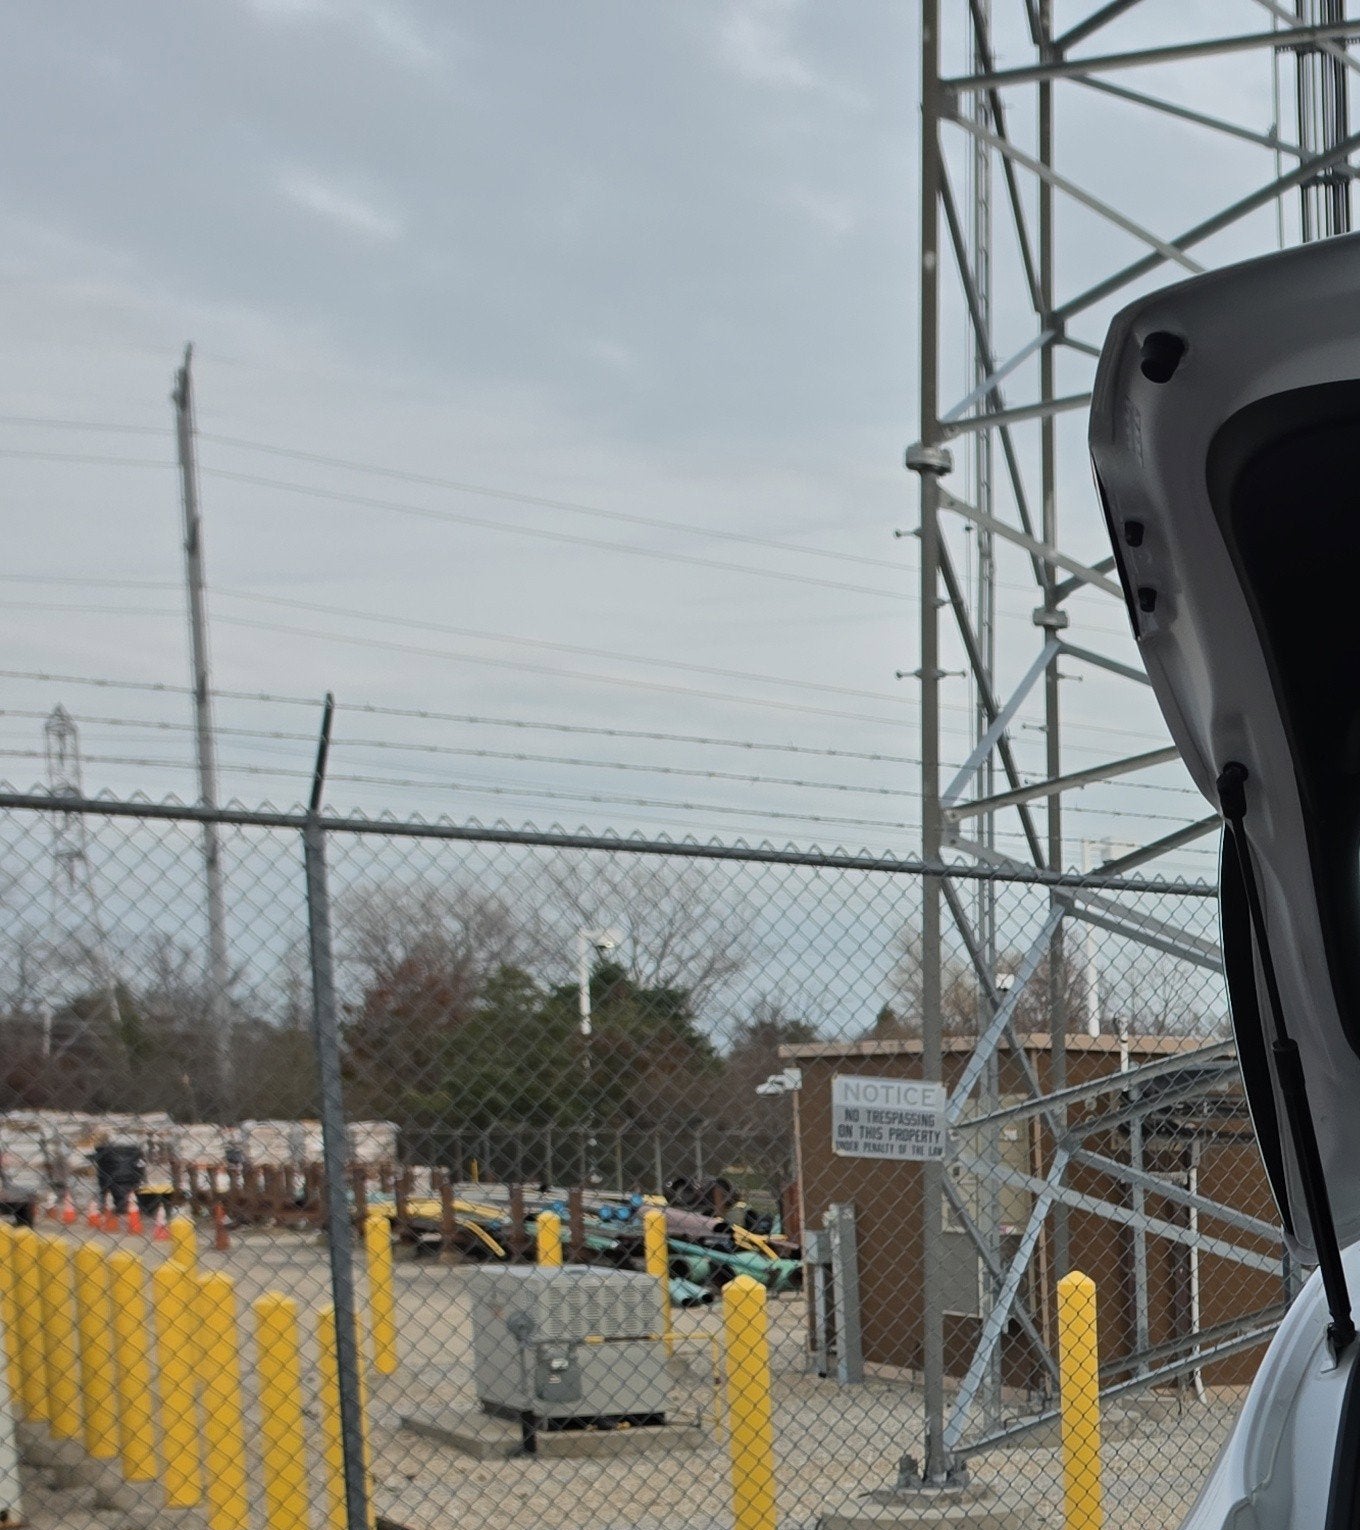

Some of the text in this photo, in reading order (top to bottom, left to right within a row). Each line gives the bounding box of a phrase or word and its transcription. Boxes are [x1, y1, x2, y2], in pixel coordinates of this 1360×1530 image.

[843, 1083, 936, 1107] NOTICE
[845, 1108, 936, 1128] NO TRESPASSING
[837, 1124, 941, 1143] ON THIS PROPERTY
